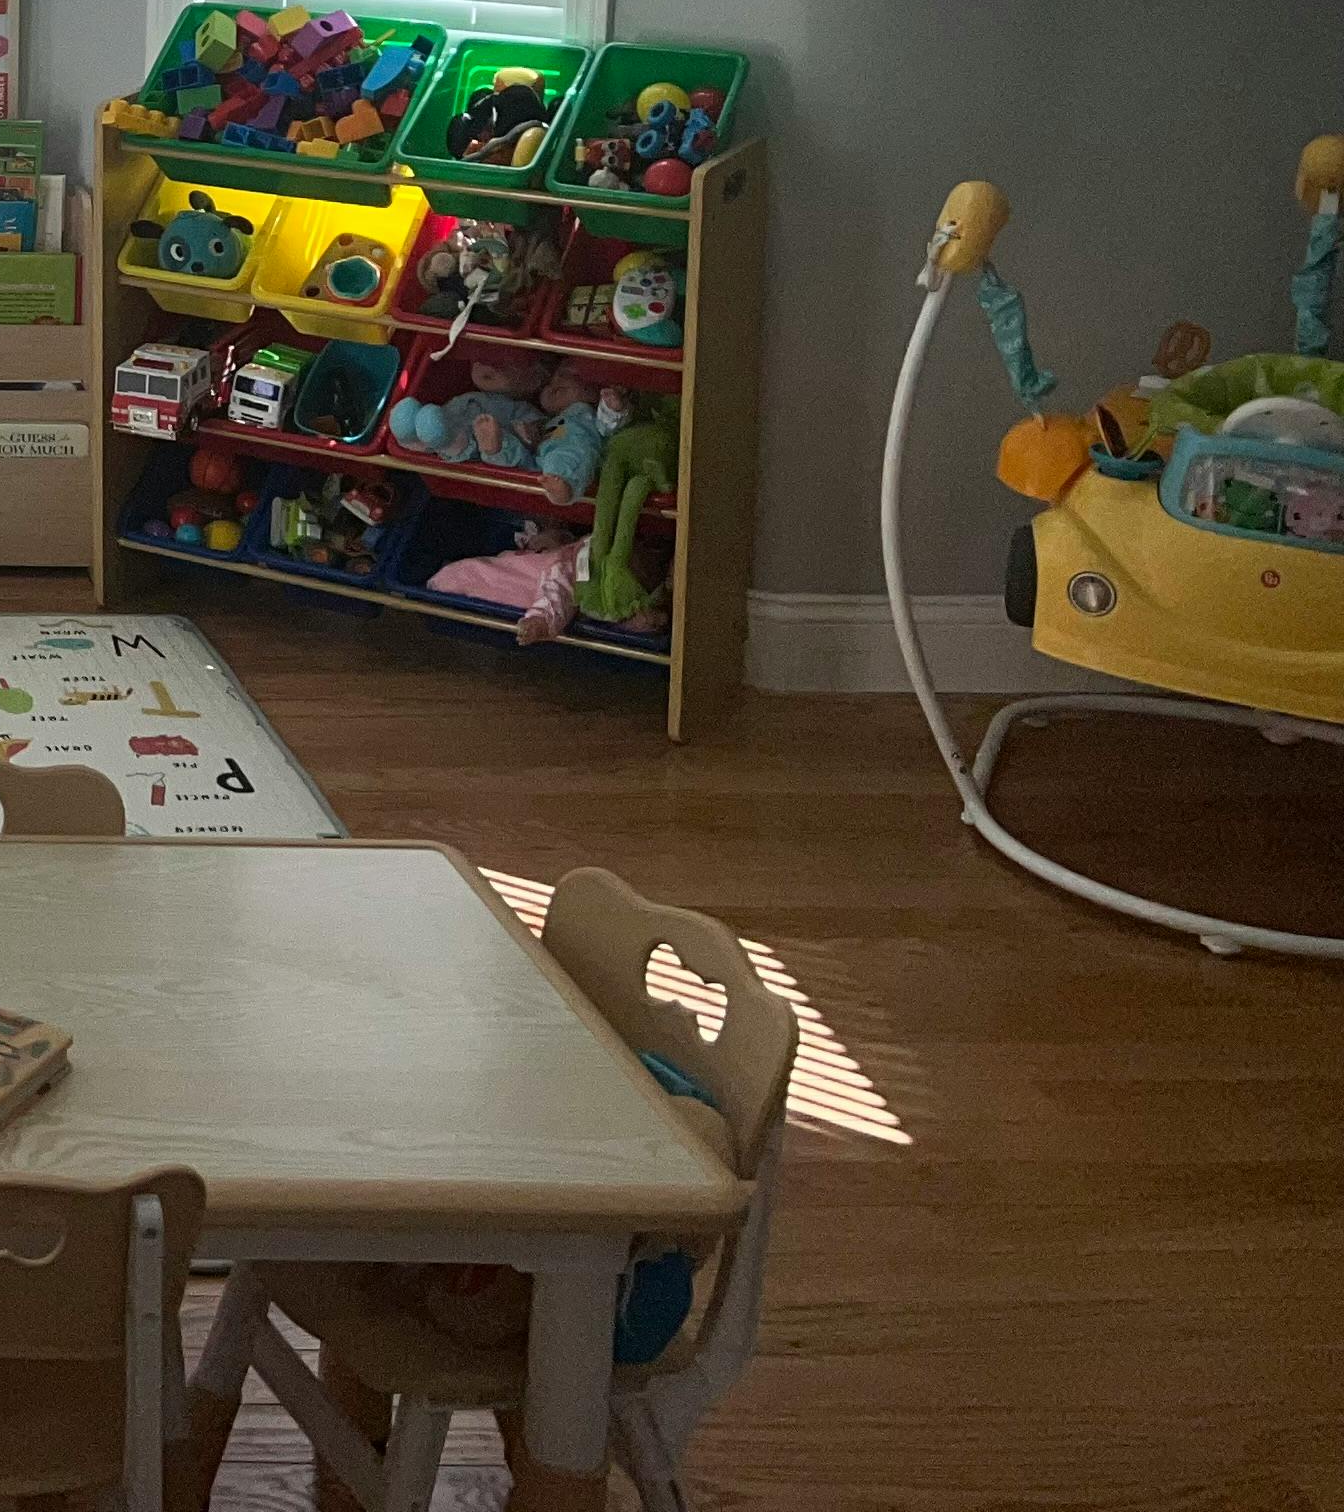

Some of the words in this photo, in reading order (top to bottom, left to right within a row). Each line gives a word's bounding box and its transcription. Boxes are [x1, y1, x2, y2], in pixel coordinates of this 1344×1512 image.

[9, 432, 56, 444] GUESS
[30, 444, 75, 456] MUCH
[112, 634, 167, 660] W
[141, 680, 201, 719] T
[44, 744, 93, 753] QUAIL
[172, 761, 198, 769] PIG
[216, 757, 256, 795] P
[174, 793, 231, 802] PENCIL
[174, 825, 244, 834] MONKEY
